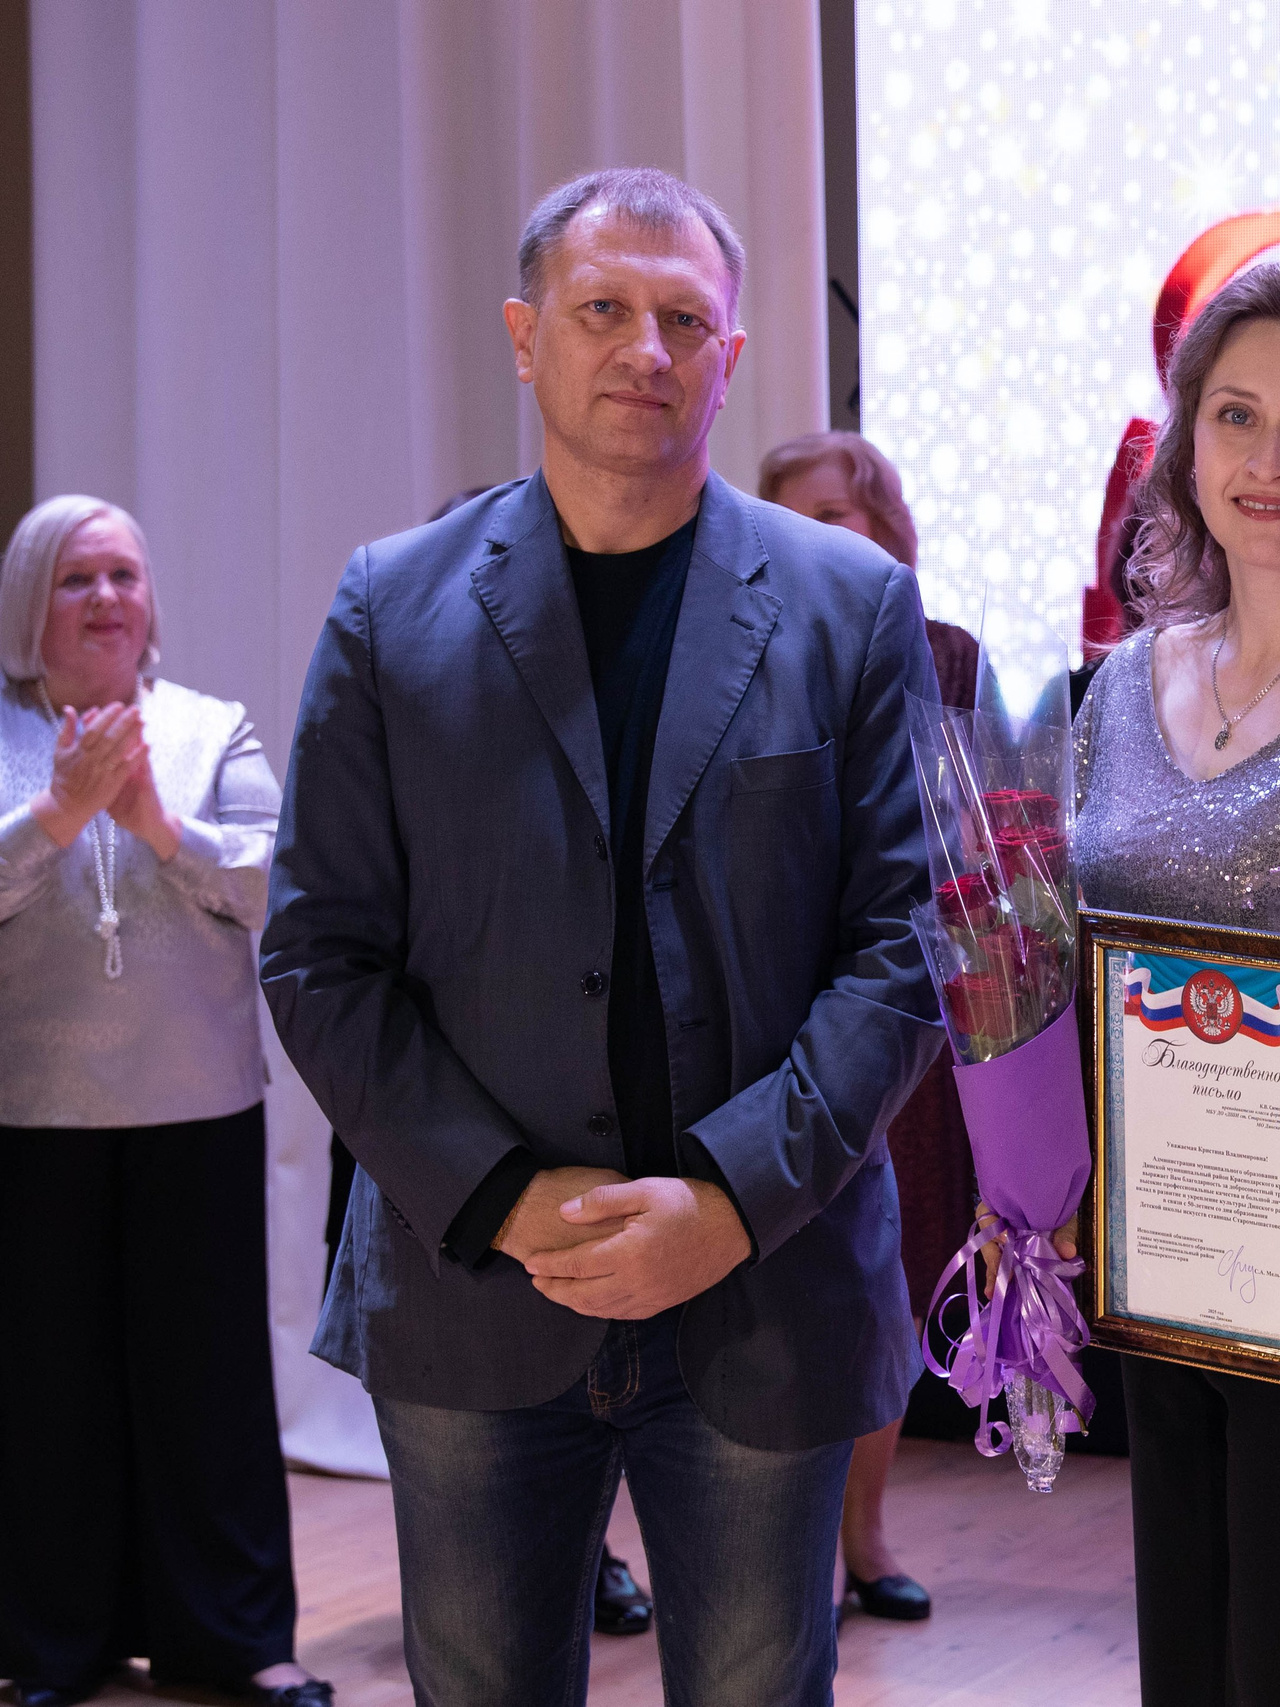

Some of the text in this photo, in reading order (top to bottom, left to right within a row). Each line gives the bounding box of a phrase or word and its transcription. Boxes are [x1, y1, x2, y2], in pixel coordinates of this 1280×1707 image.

[1192, 1084, 1242, 1101] письмо
[1167, 1141, 1268, 1163] Уважаемая Кристина Владимировна!
[1142, 1162, 1166, 1171] Динской
[1166, 1167, 1211, 1178] муниципальный
[1212, 1173, 1229, 1182] район
[1230, 1176, 1275, 1189] Краснодарского
[1153, 1156, 1278, 1180] Администрация муниципального образования
[1142, 1171, 1169, 1179] выражает
[1182, 1176, 1221, 1188] благодарность
[1229, 1184, 1273, 1196] добросовестный
[1163, 1182, 1214, 1195] профессиональные
[1246, 1194, 1270, 1203] большой
[1157, 1190, 1181, 1198] развитие
[1187, 1195, 1218, 1204] укрепление
[1220, 1200, 1246, 1209] культуры
[1247, 1203, 1274, 1212] Динского
[1188, 1201, 1214, 1210] 50-летием
[1233, 1209, 1268, 1220] образования
[1140, 1202, 1162, 1210] Детской
[1183, 1210, 1207, 1218] искусств
[1208, 1214, 1232, 1222] станицы
[1153, 1238, 1194, 1248] муниципального
[1195, 1245, 1225, 1254] образования
[1173, 1233, 1204, 1243] обязанности
[1138, 1249, 1176, 1260] Краснодарского
[1200, 1252, 1214, 1260] район
